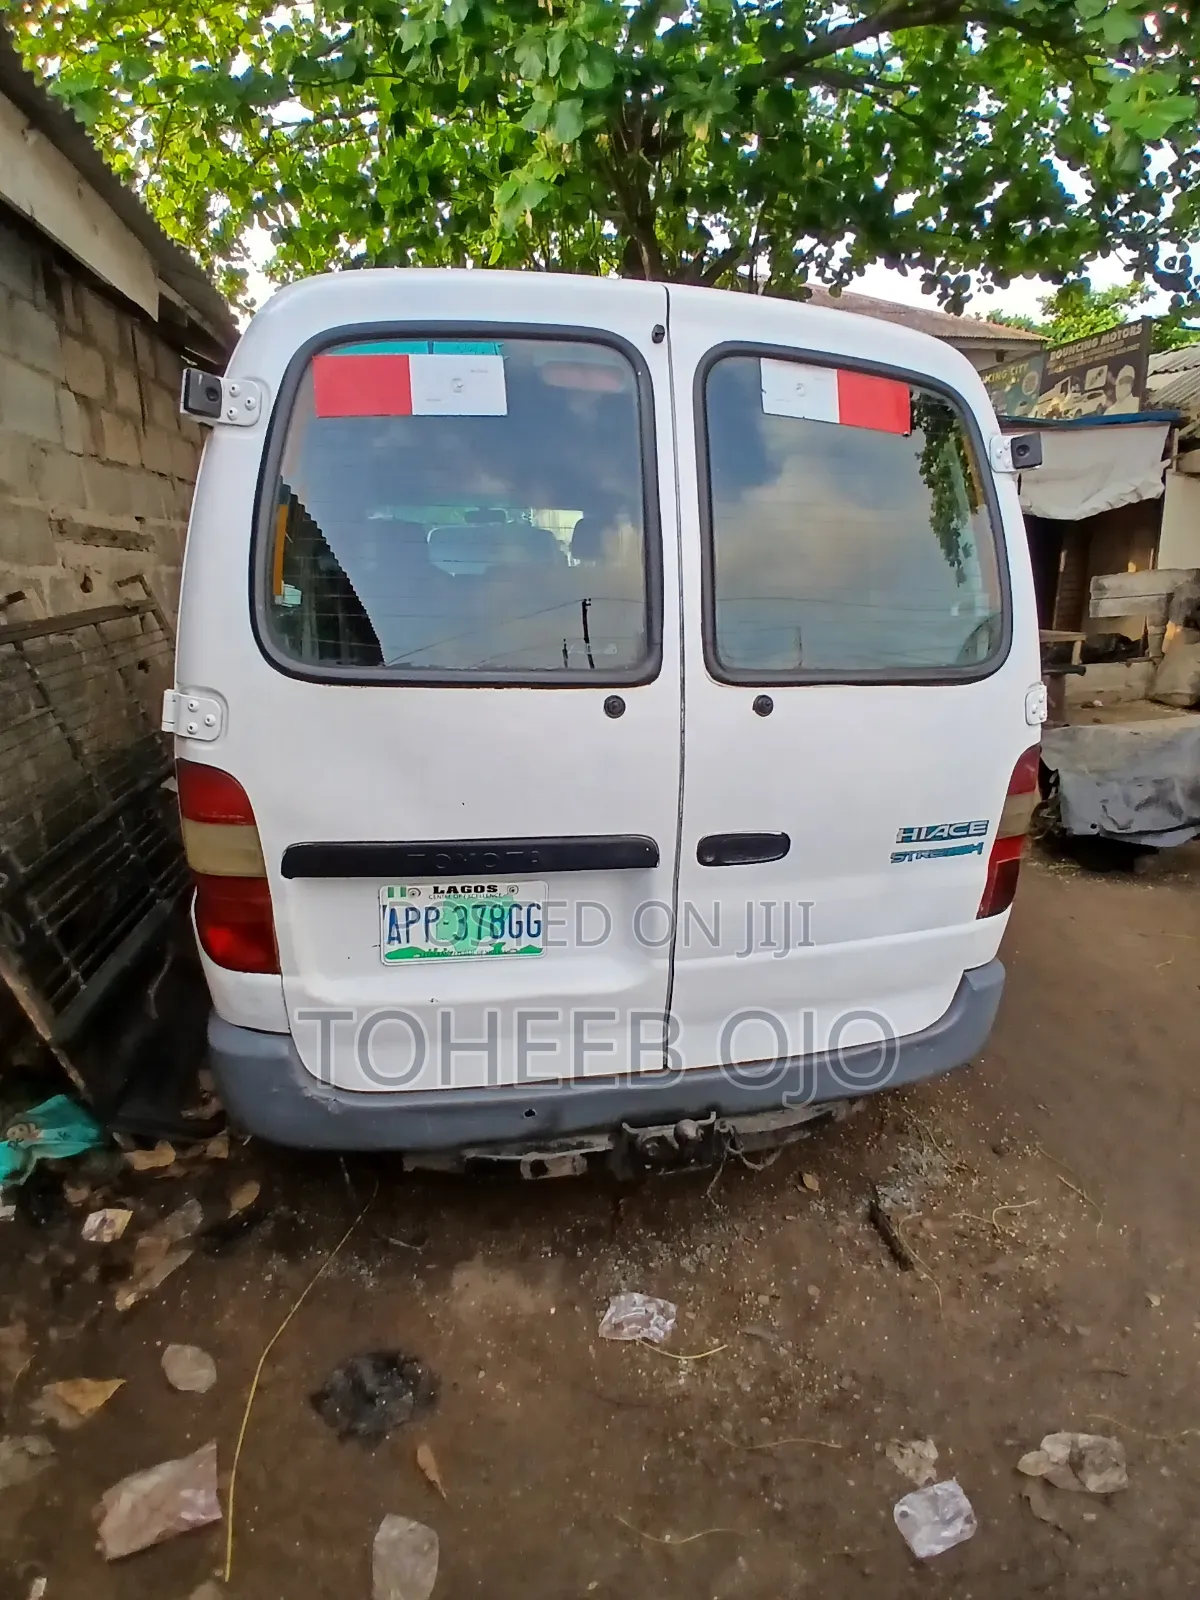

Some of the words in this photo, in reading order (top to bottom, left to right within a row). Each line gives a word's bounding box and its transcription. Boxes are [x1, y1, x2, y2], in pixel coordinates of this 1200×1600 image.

[1100, 322, 1143, 346] MOTORS
[896, 820, 989, 843] HIACE
[433, 885, 498, 894] LAGOS
